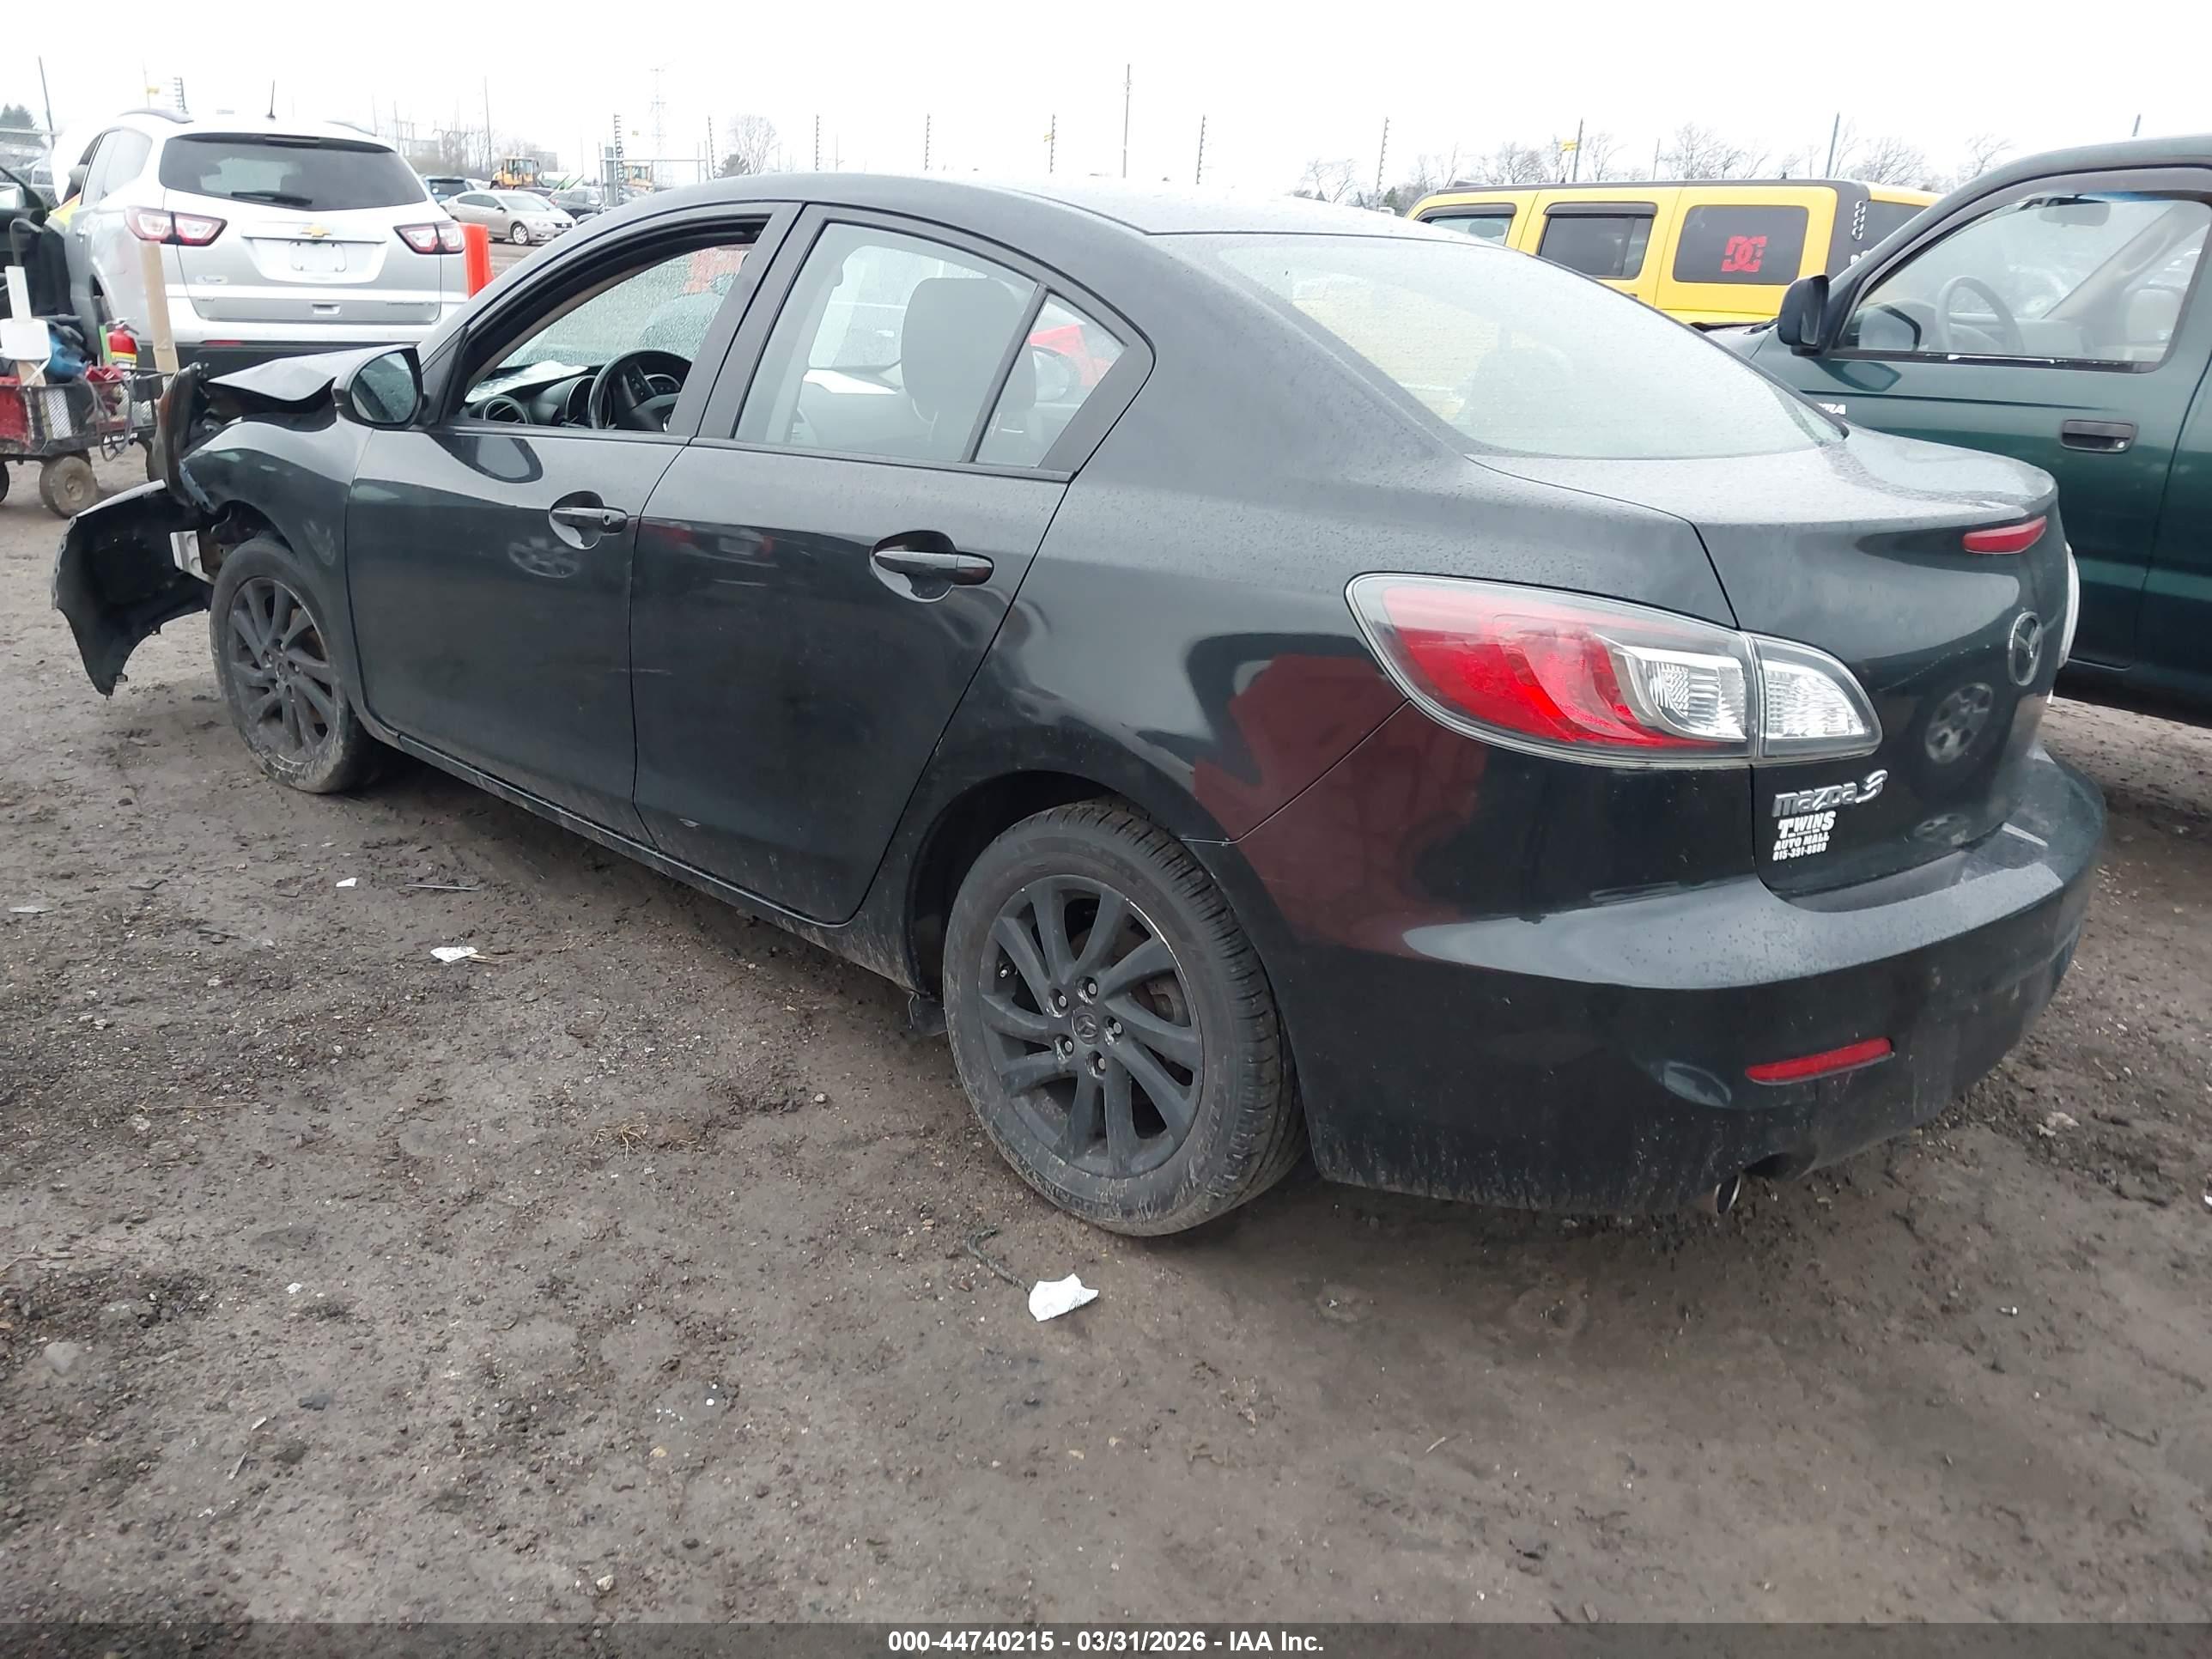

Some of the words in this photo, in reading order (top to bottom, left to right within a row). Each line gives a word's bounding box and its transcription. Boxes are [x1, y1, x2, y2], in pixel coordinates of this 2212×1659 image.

[1778, 811, 1837, 840] TWINS
[1773, 836, 1802, 852] AUTO
[1803, 831, 1830, 846] MALL
